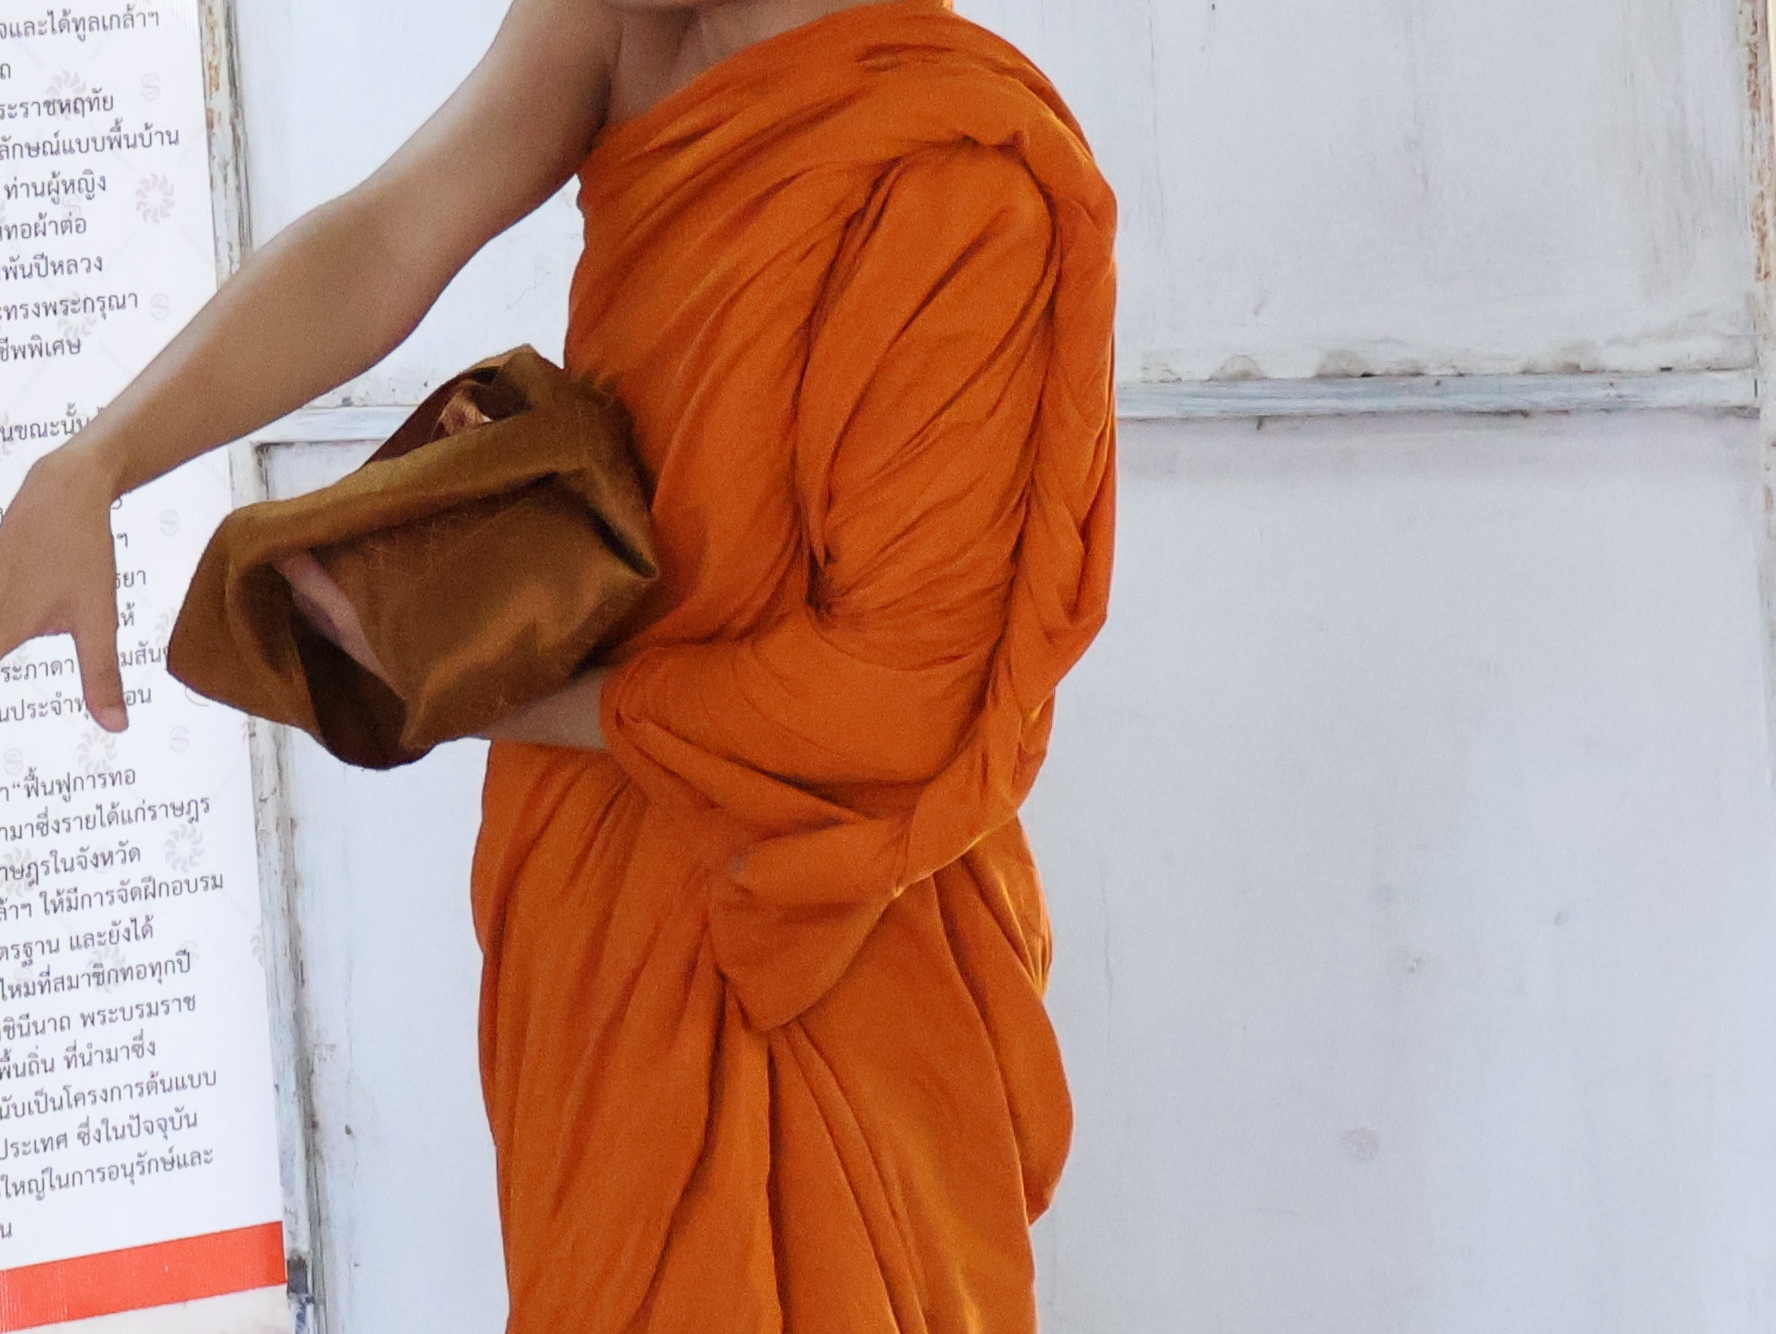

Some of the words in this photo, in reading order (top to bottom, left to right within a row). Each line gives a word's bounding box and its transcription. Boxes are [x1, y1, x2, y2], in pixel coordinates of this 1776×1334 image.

[2, 168, 106, 205] ท่านผู้หญิง
[37, 873, 223, 916] ให้มีการจัดฝึกอบรม
[68, 913, 154, 951] และยังได้
[79, 993, 196, 1028] พระบรมราช
[62, 1027, 156, 1070] ที่นำมาซึ่ง
[76, 1105, 198, 1146] ซึ่งในปัจจุบัน
